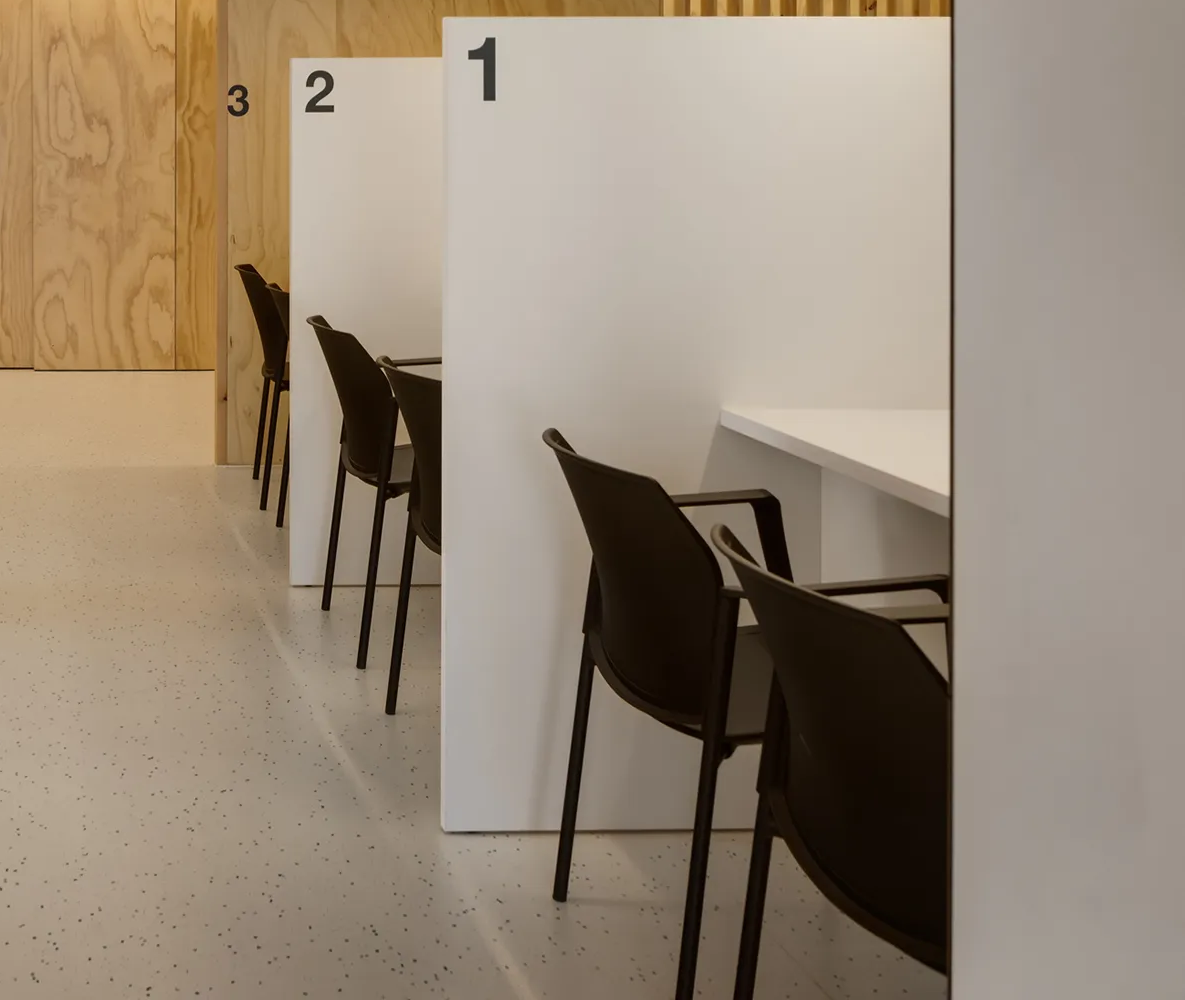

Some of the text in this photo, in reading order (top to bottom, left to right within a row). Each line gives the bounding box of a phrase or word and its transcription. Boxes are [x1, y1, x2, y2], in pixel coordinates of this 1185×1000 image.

[304, 69, 335, 113] 2
[467, 36, 497, 102] 1
[226, 84, 250, 117] 3
